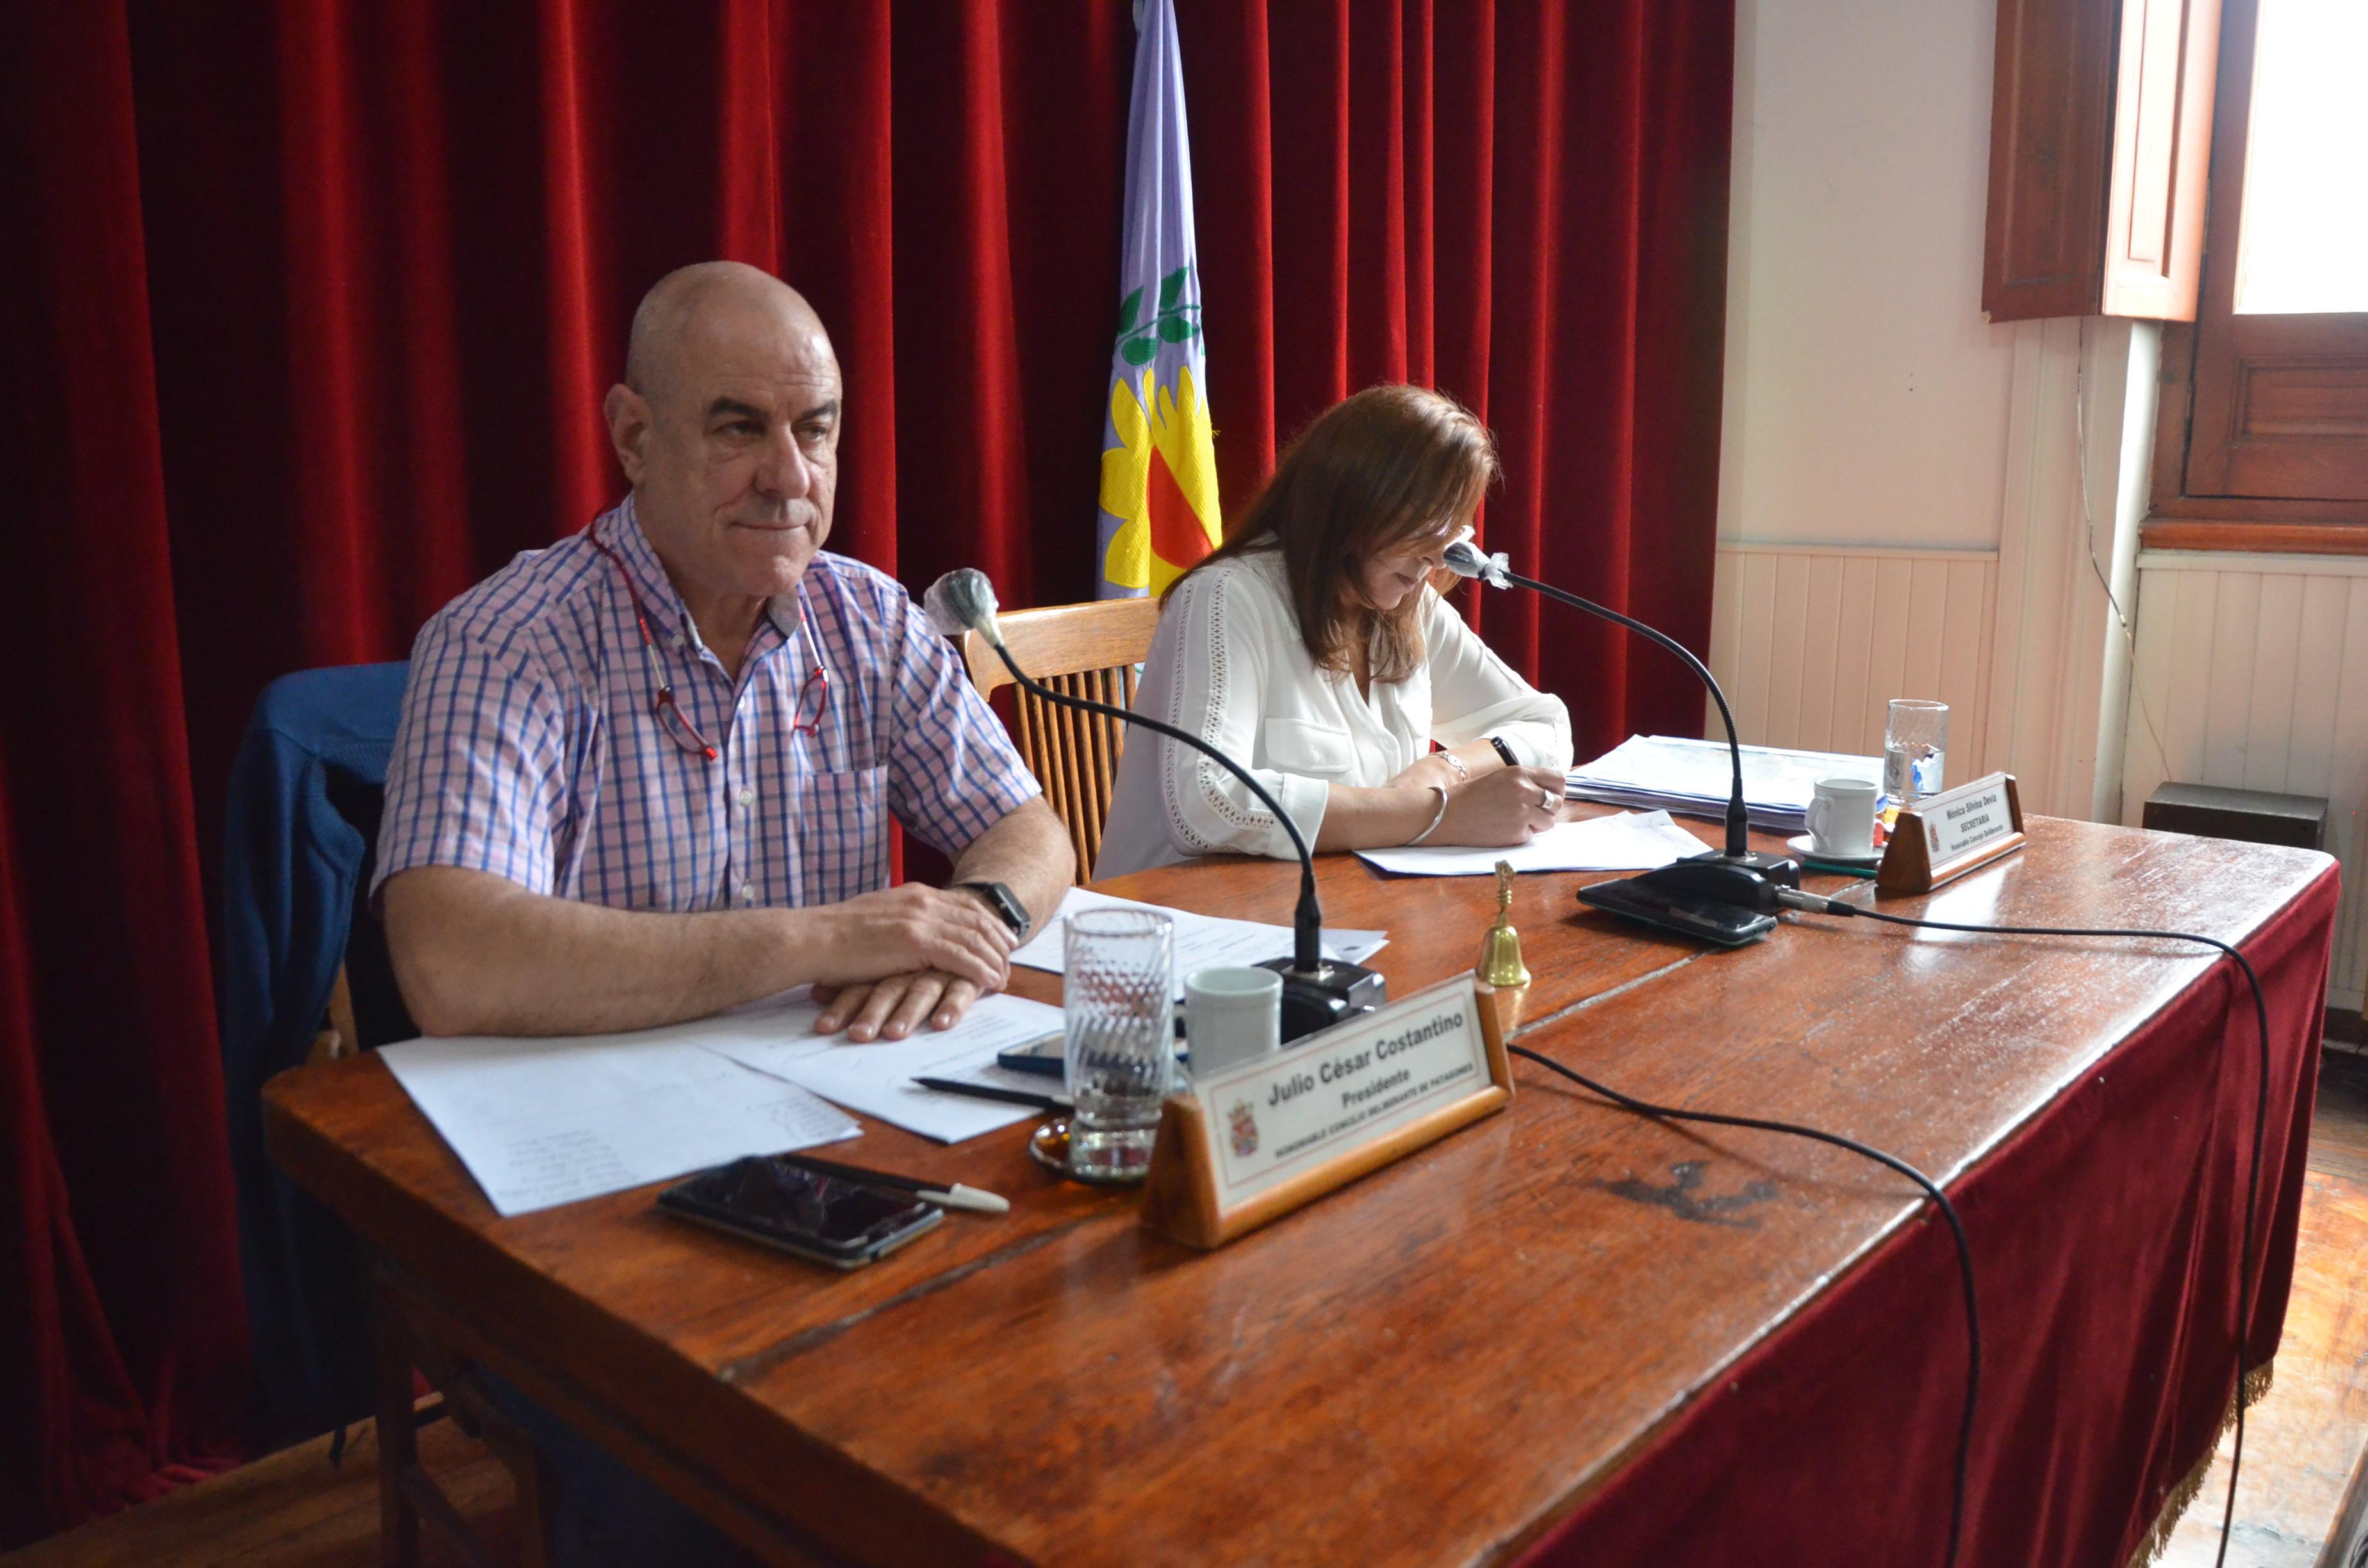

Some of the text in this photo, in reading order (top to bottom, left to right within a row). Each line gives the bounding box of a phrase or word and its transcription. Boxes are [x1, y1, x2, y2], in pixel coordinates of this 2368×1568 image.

[1961, 814, 1990, 833] SECRETARIA
[1966, 800, 1982, 812] Silvina
[1268, 1011, 1463, 1107] Julio César Costantino
[1342, 1068, 1411, 1107] Presidente
[1276, 1063, 1473, 1158] HONORABLE CONCEJO DELIBERANTE DE PATAGONES
